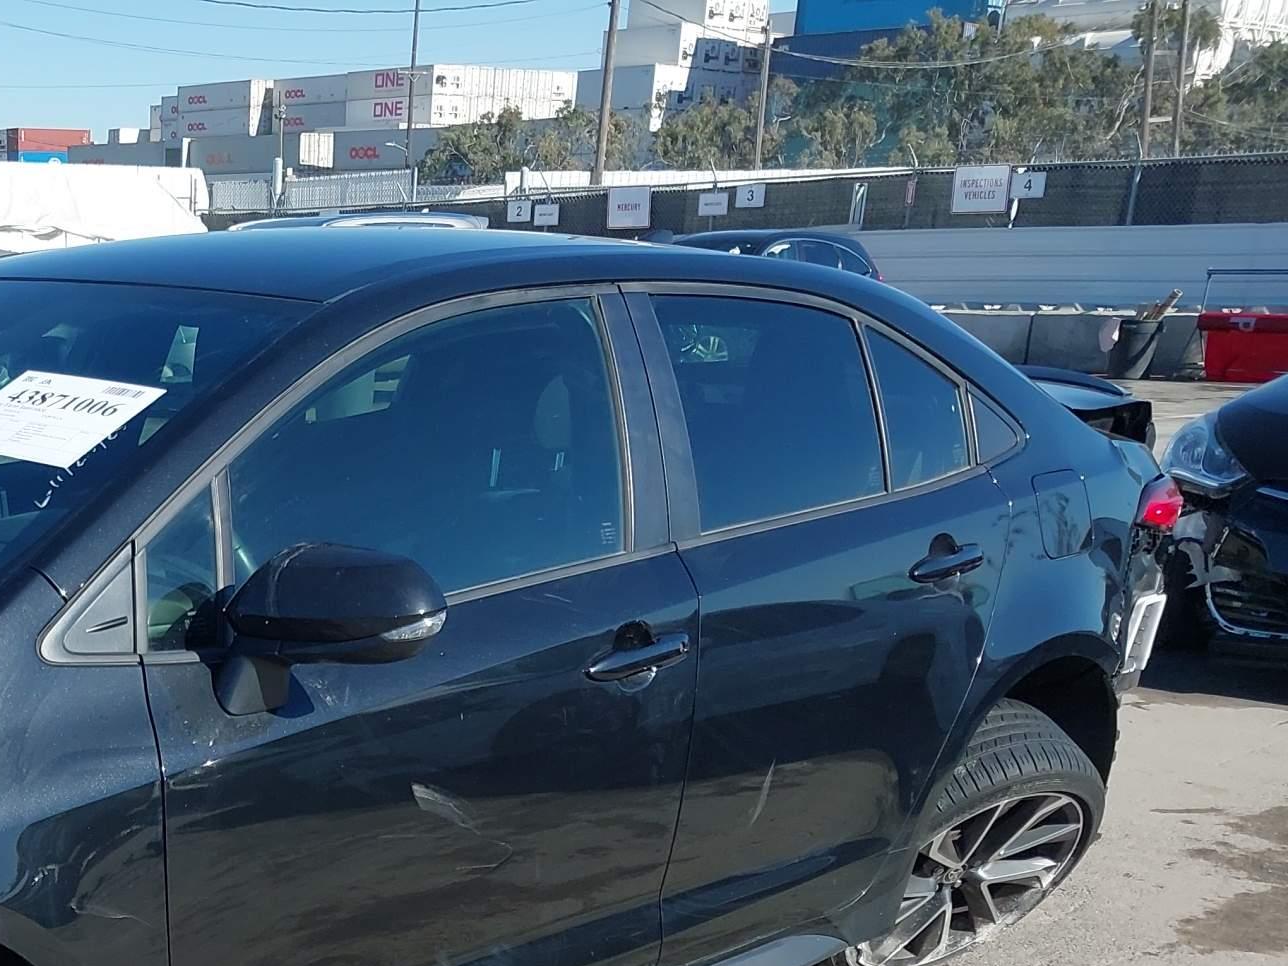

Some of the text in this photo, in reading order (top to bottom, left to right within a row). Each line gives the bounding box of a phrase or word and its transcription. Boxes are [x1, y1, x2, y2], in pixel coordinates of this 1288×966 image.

[374, 72, 404, 89] ONE
[187, 95, 208, 104] OOCL
[285, 89, 306, 99] OOCL
[373, 101, 403, 118] ONE
[187, 122, 208, 132] OOCL
[350, 146, 380, 159] OOCL
[959, 178, 1003, 189] INSPECTIONS
[1023, 179, 1032, 192] 4
[746, 189, 754, 202] 3
[963, 190, 996, 201] VEHICLES
[516, 206, 523, 217] 2
[8, 388, 127, 417] 43871006
